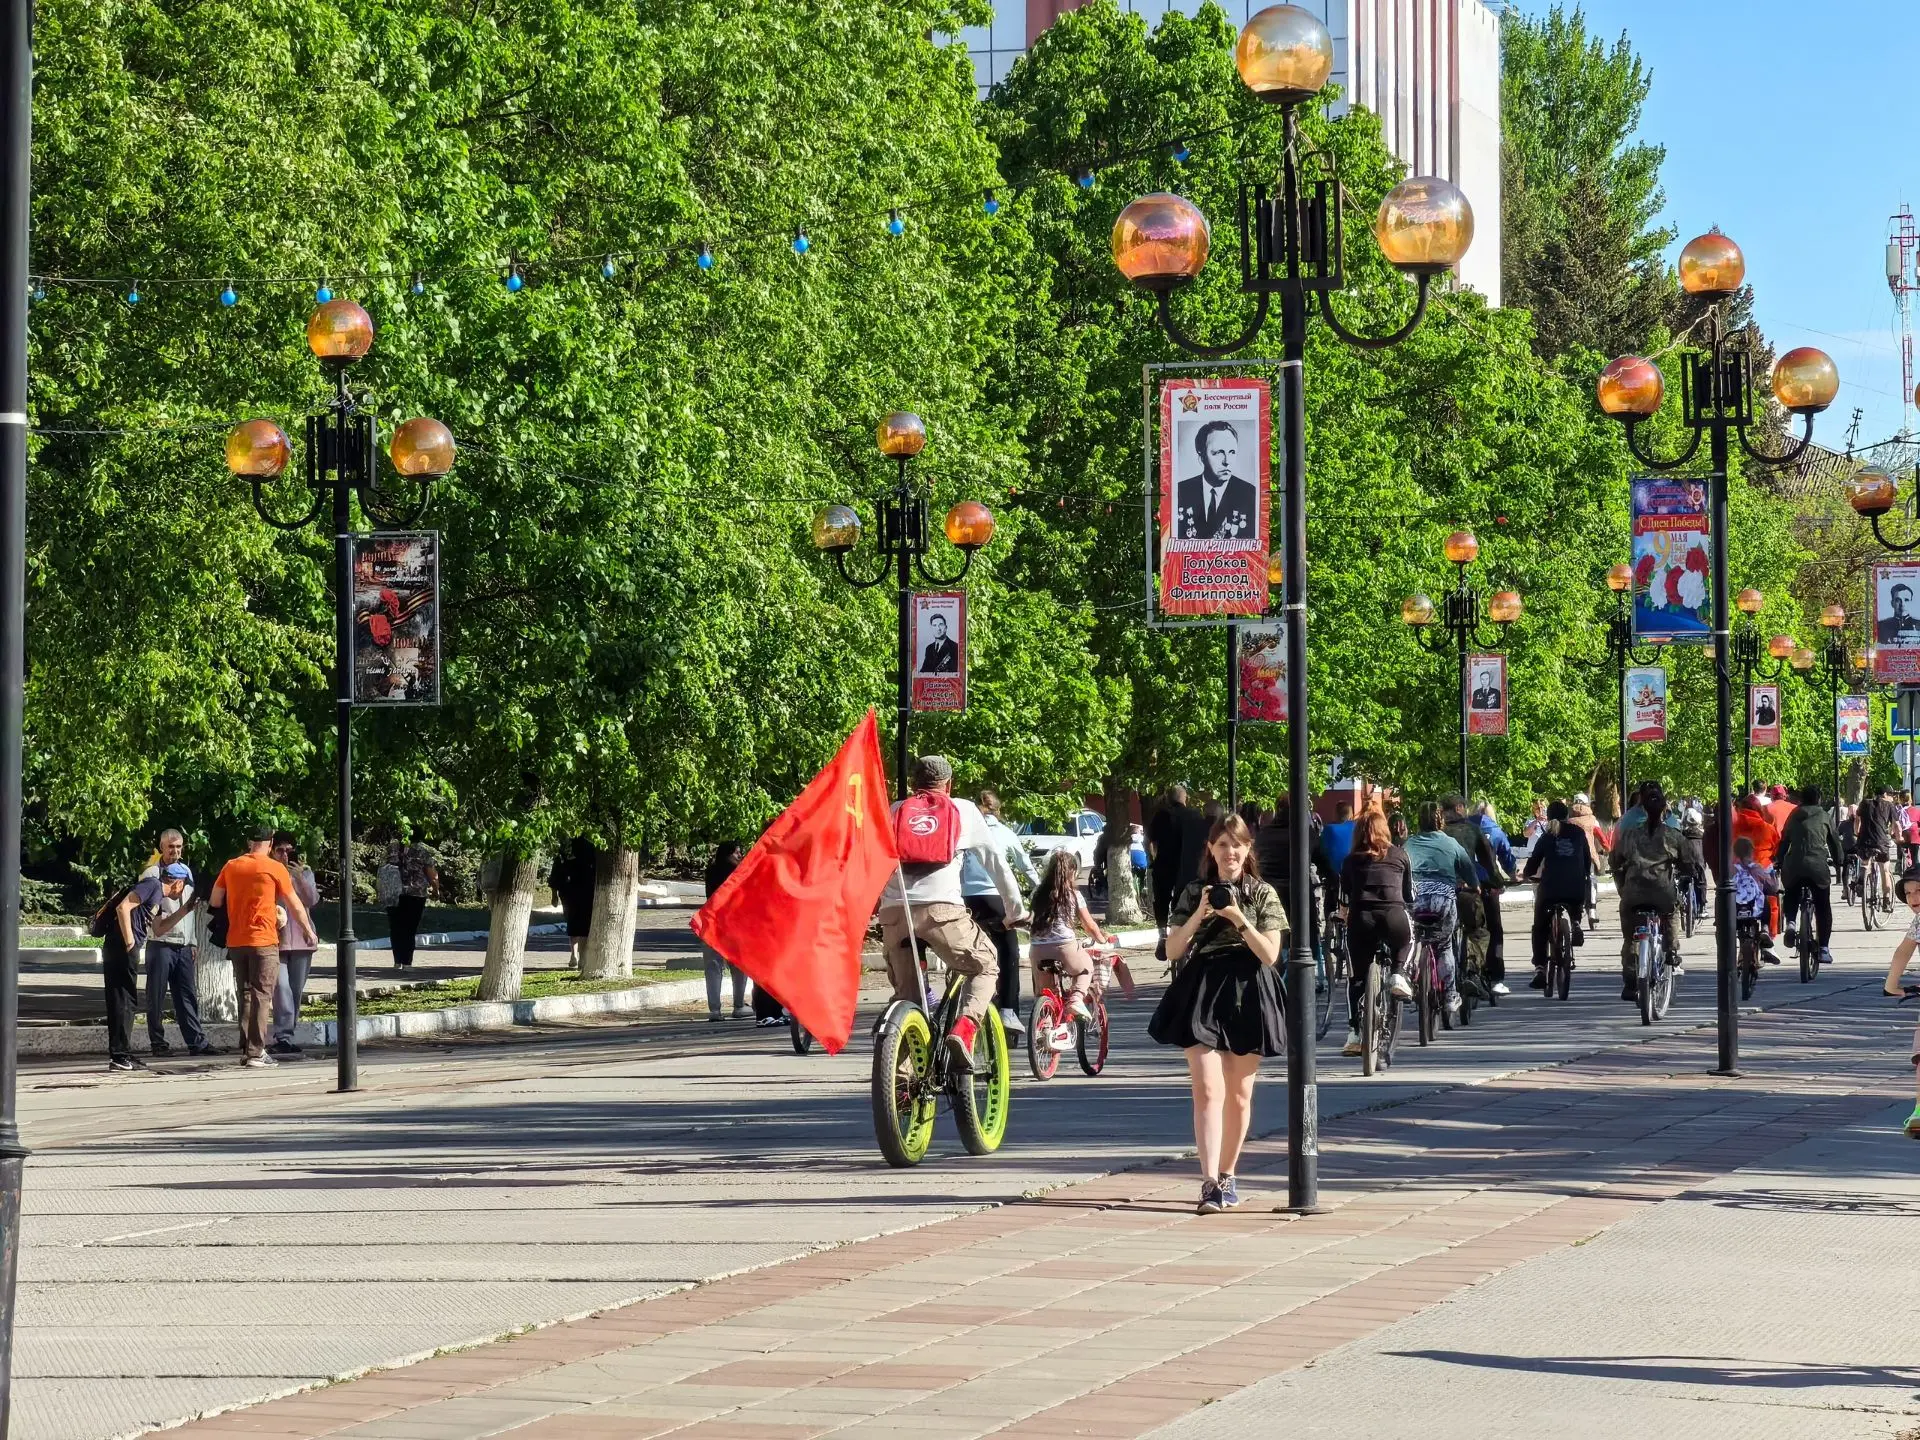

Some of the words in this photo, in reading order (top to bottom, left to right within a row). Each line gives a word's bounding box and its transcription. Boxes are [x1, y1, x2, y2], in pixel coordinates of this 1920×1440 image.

[1204, 393, 1252, 402] Бессмертный
[1223, 402, 1248, 410] России
[1653, 530, 1671, 568] 9
[1671, 532, 1687, 543] МАЯ
[1182, 555, 1249, 573] Голубков
[1181, 571, 1249, 585] Всеволод
[1169, 586, 1261, 600] Филиппович
